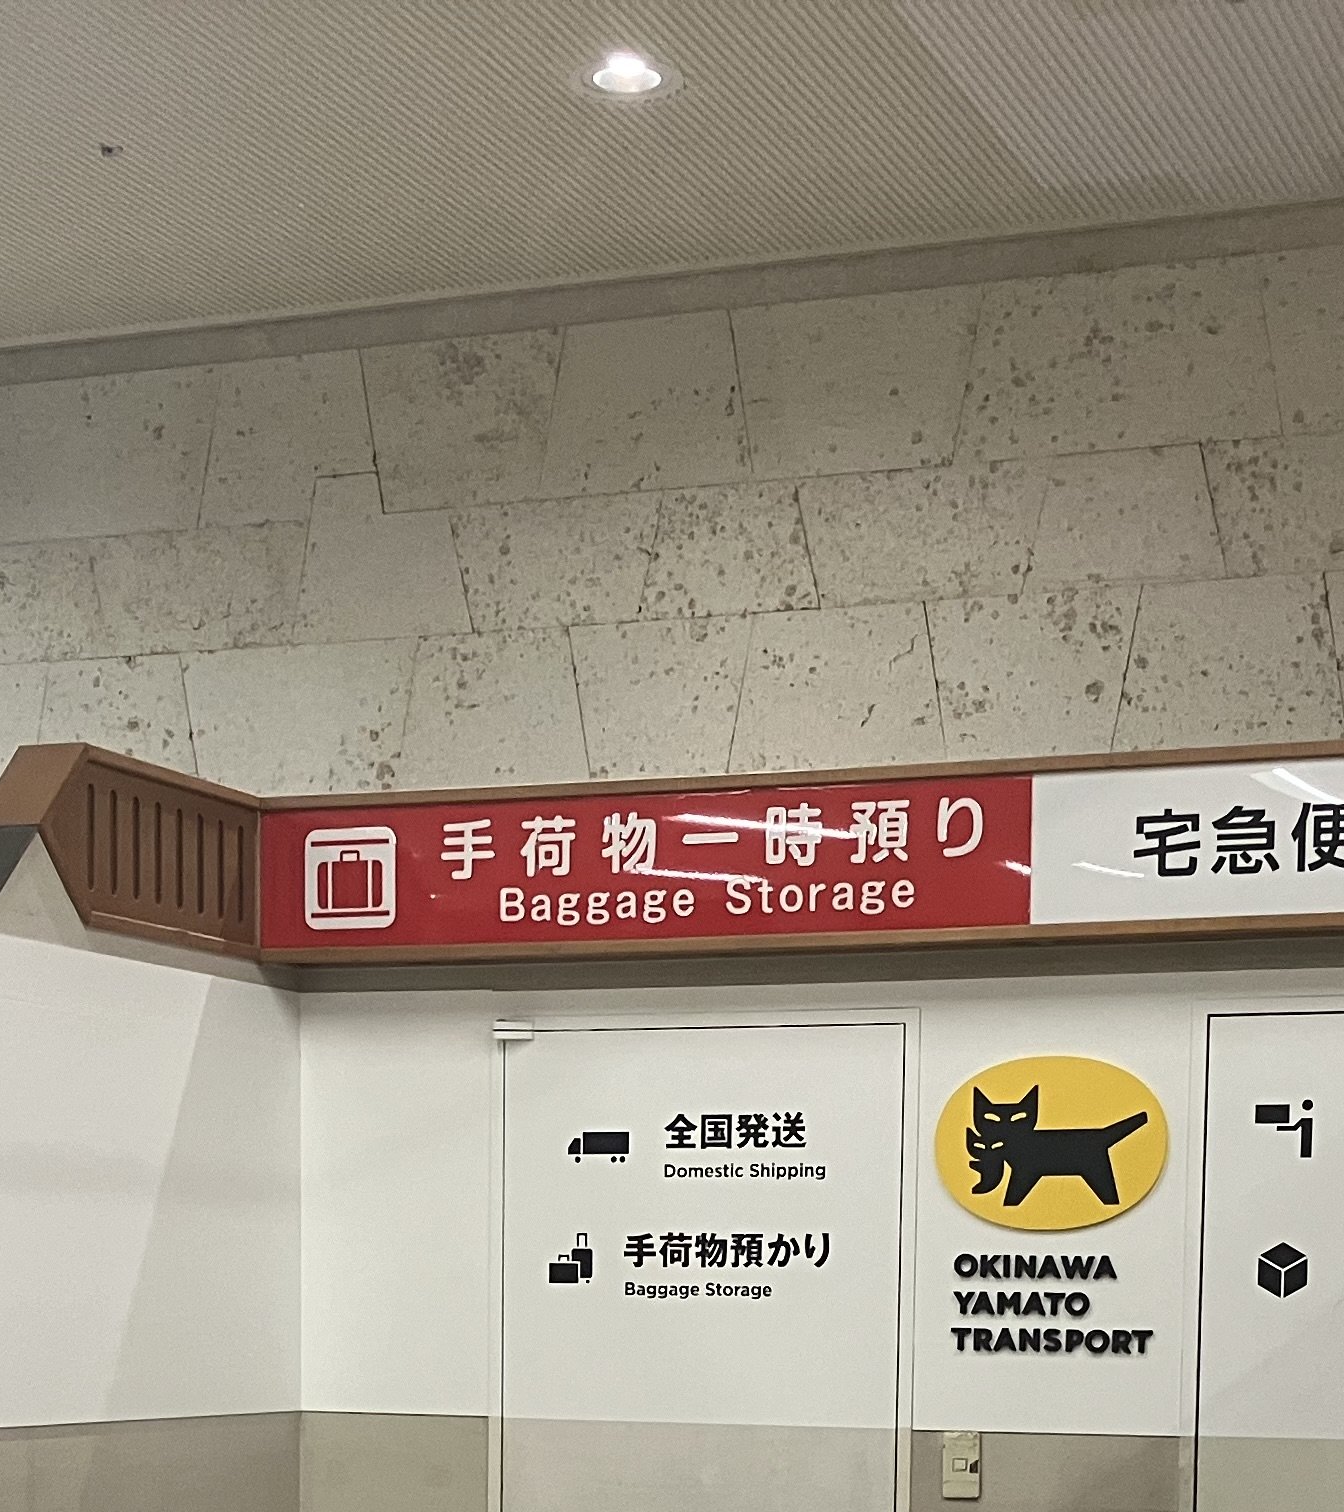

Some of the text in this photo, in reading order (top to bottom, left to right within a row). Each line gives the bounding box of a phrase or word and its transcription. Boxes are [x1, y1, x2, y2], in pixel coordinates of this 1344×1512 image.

[441, 796, 986, 881] 手荷物一時預り
[499, 876, 916, 926] Baggage Storage
[665, 1112, 807, 1150] 全国発送
[663, 1161, 827, 1182] Domestic Shipping
[624, 1232, 831, 1270] 手荷物預かり
[952, 1253, 1118, 1282] OKINAWA
[624, 1281, 772, 1301] Baggage Storage
[952, 1291, 1091, 1318] YAMATO
[951, 1327, 1155, 1356] TRANSPORT
